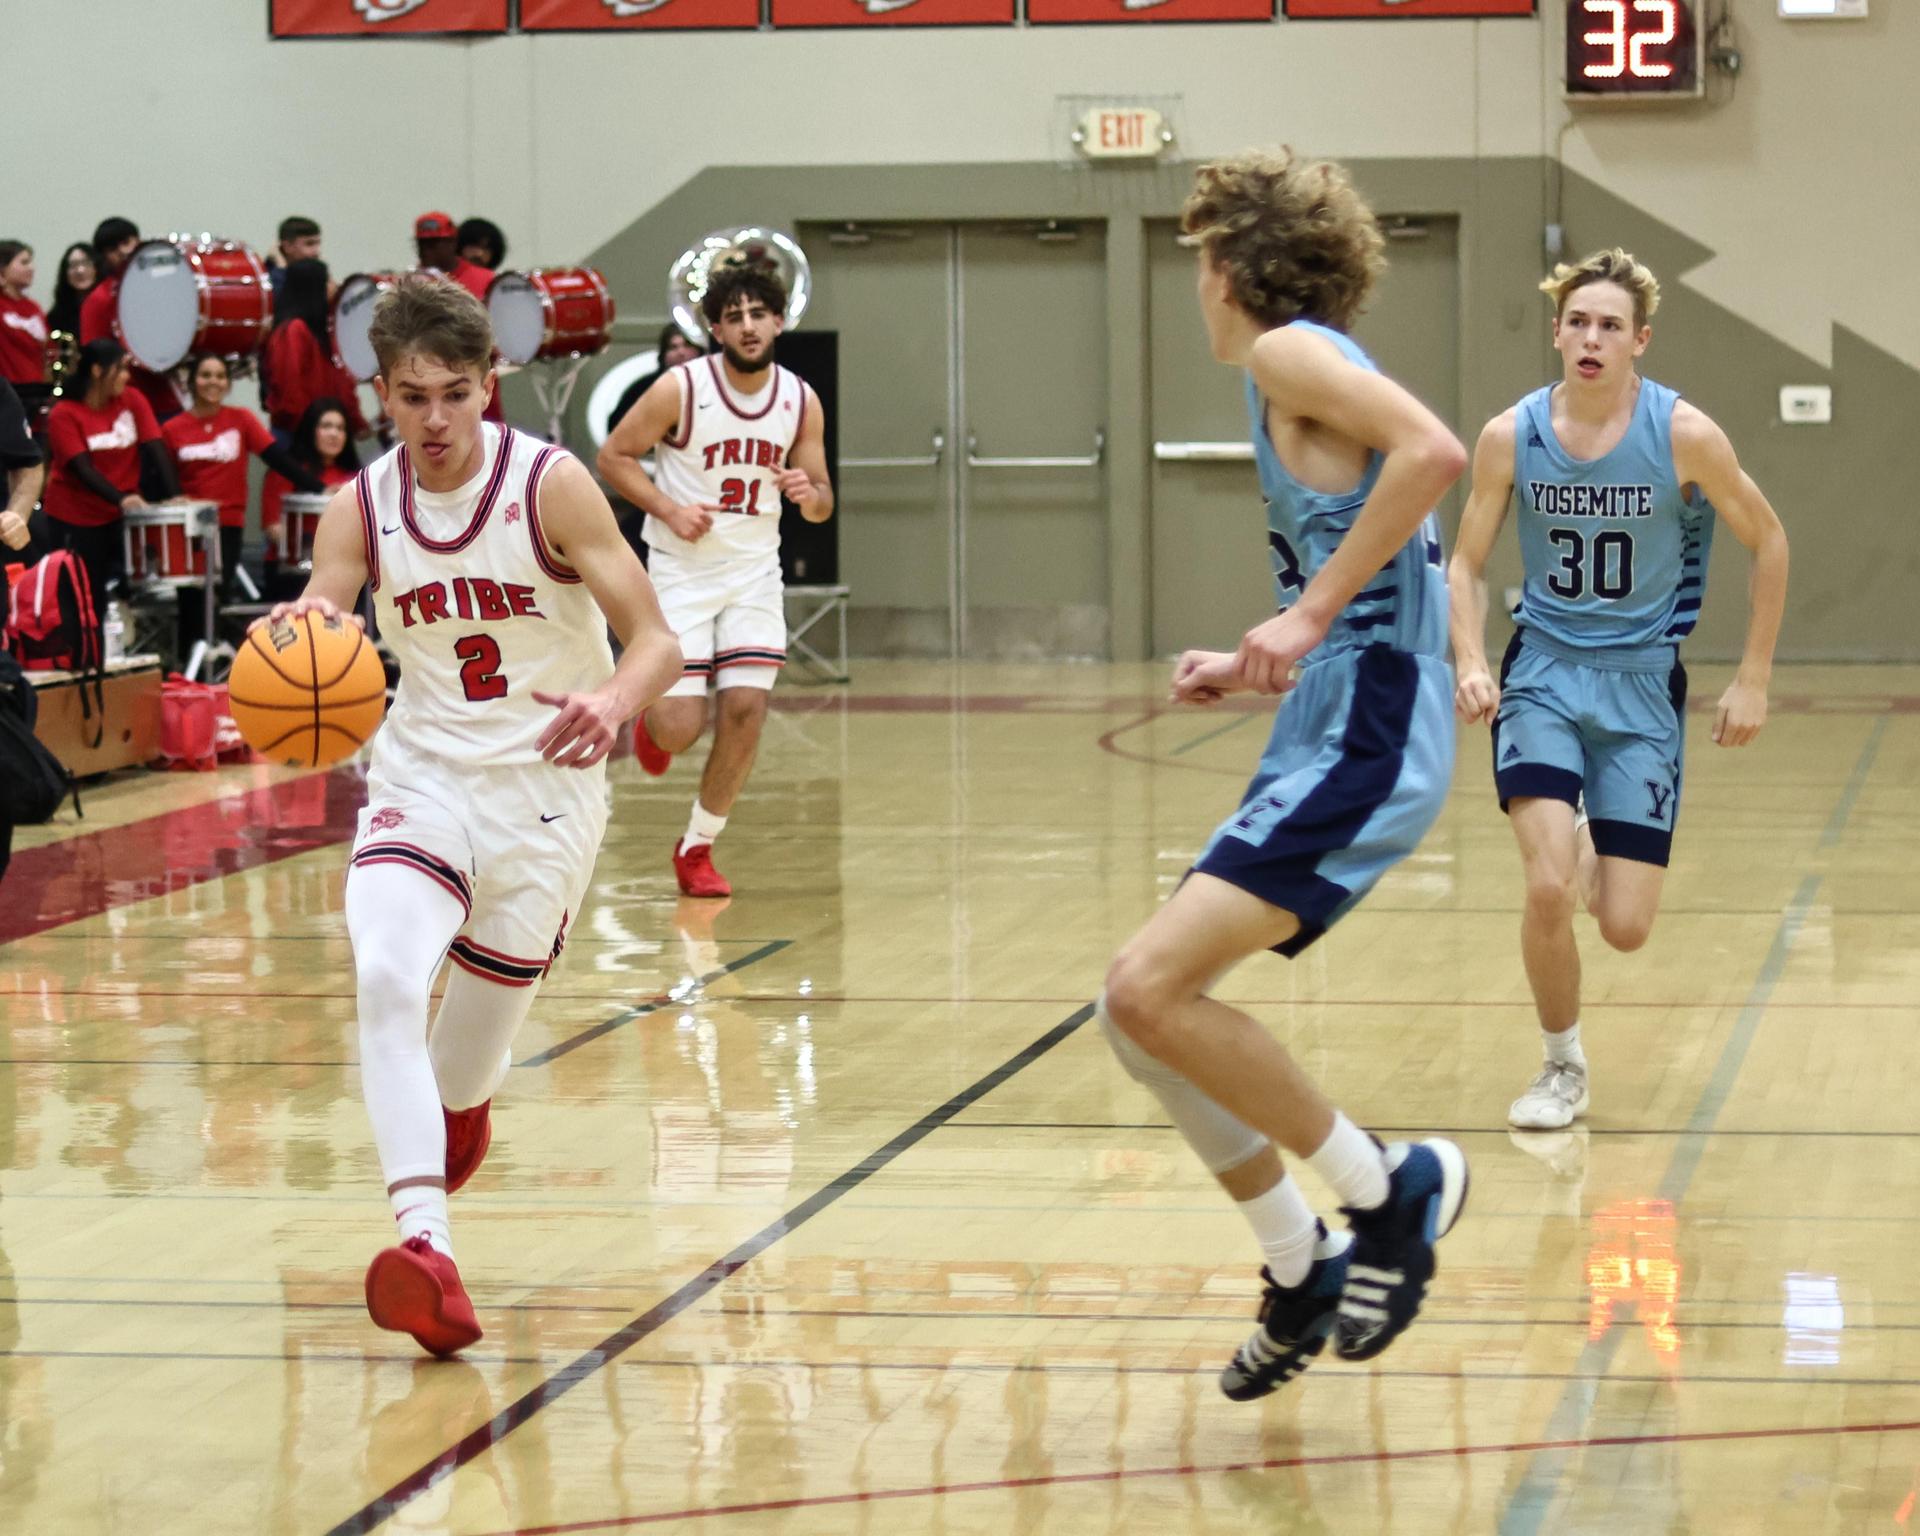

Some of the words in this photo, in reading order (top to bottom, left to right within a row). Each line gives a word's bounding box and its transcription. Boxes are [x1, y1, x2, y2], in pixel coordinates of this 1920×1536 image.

[1583, 0, 1676, 78] 32
[1100, 113, 1145, 148] EXIT
[720, 478, 761, 516] 21
[1529, 480, 1653, 519] YOSEMITE
[1548, 528, 1635, 601] 30
[393, 577, 547, 628] TRIBE
[453, 633, 508, 702] 2
[1643, 778, 1672, 821] Y
